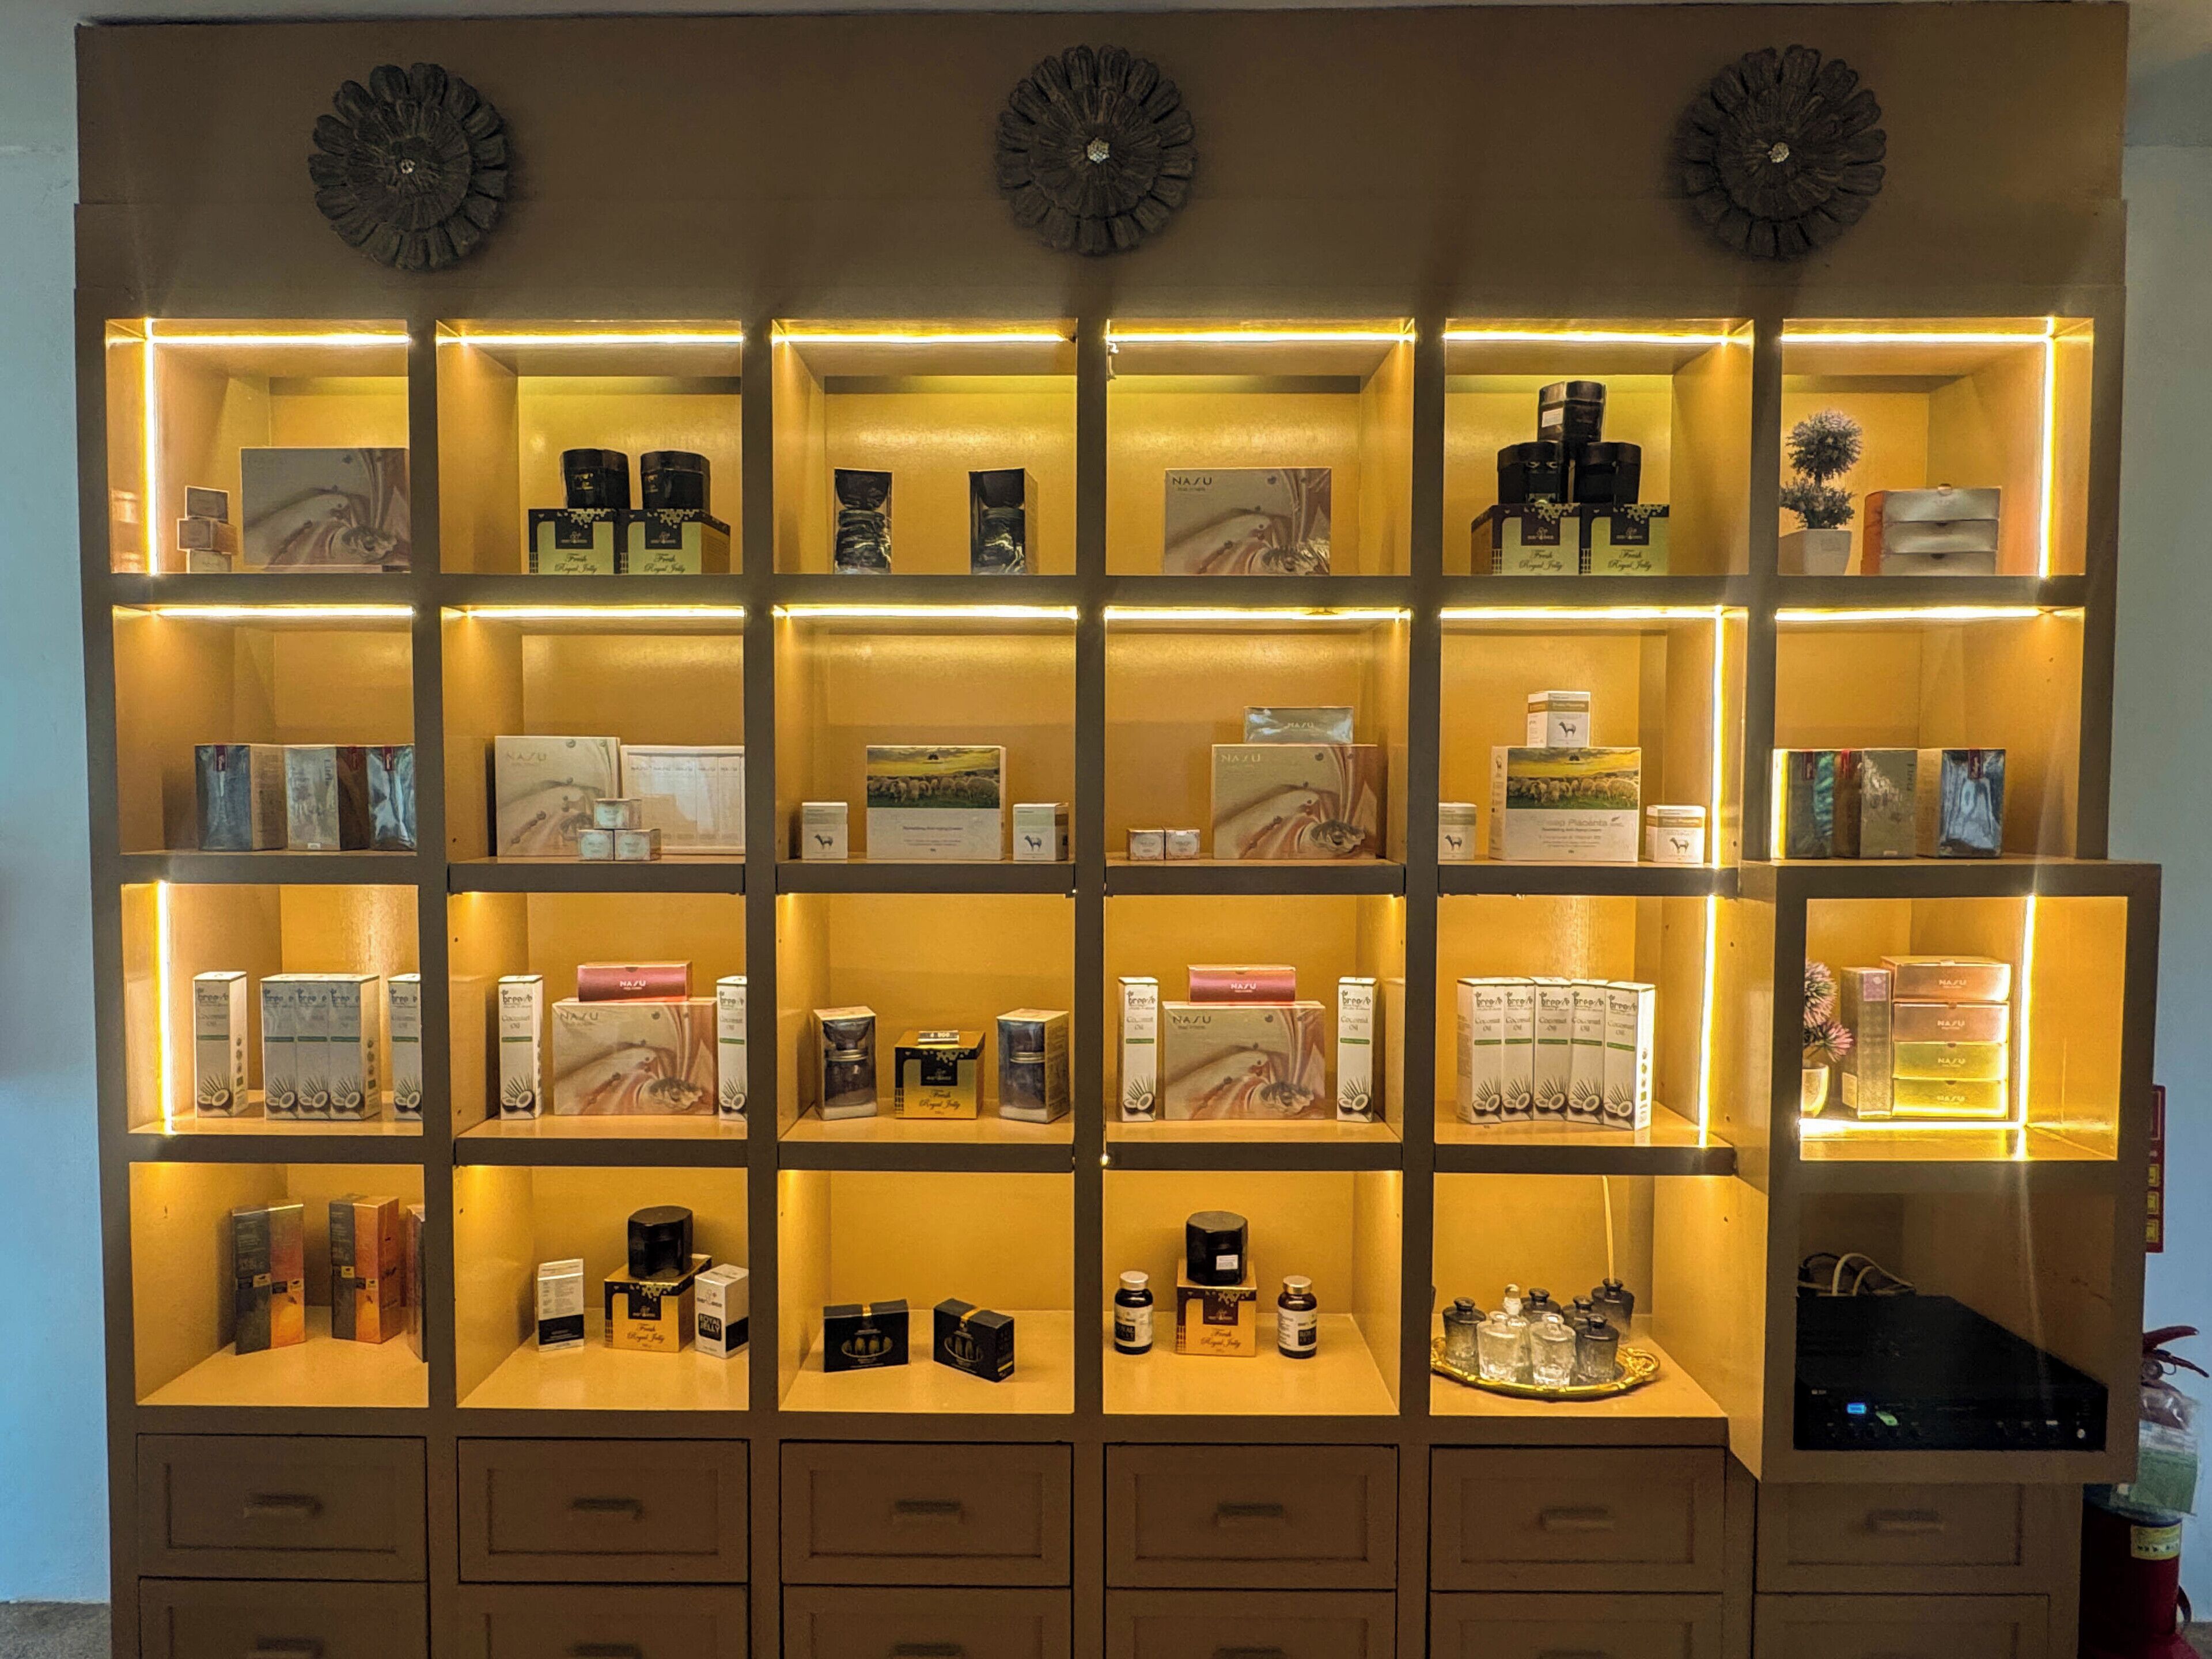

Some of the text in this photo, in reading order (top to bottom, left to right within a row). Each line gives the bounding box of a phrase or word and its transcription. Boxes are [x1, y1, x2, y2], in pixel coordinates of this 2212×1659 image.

[1172, 477, 1212, 485] NASU
[1221, 753, 1260, 762] NASU
[559, 1012, 599, 1020] NASU
[1173, 1016, 1211, 1024] NASU
